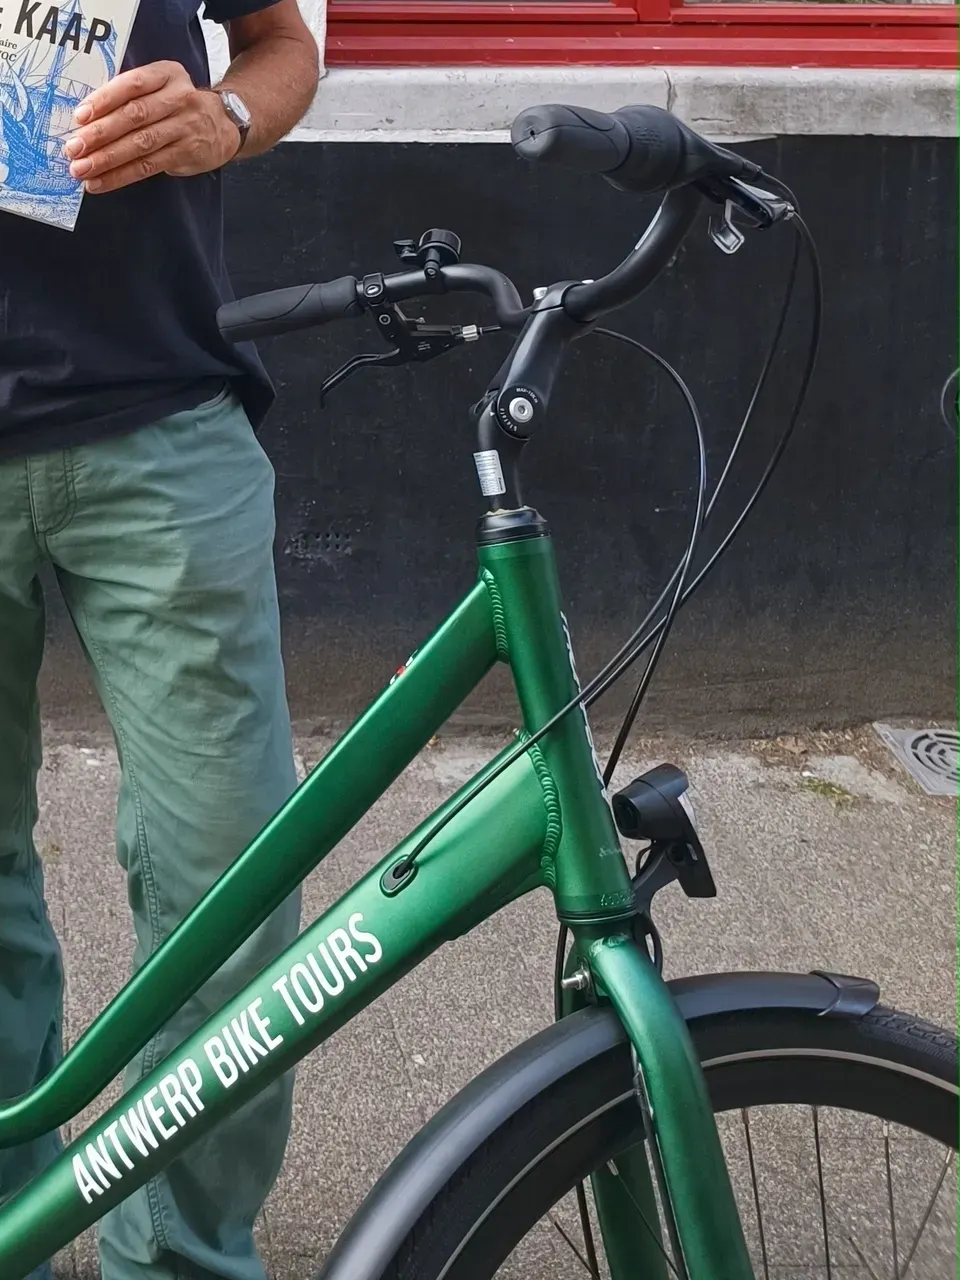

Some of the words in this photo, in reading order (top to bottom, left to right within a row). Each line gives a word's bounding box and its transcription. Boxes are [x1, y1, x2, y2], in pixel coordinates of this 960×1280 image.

[70, 1058, 206, 1205] ANTWERP
[203, 996, 284, 1090] BIKE
[271, 911, 384, 1027] TOURS
